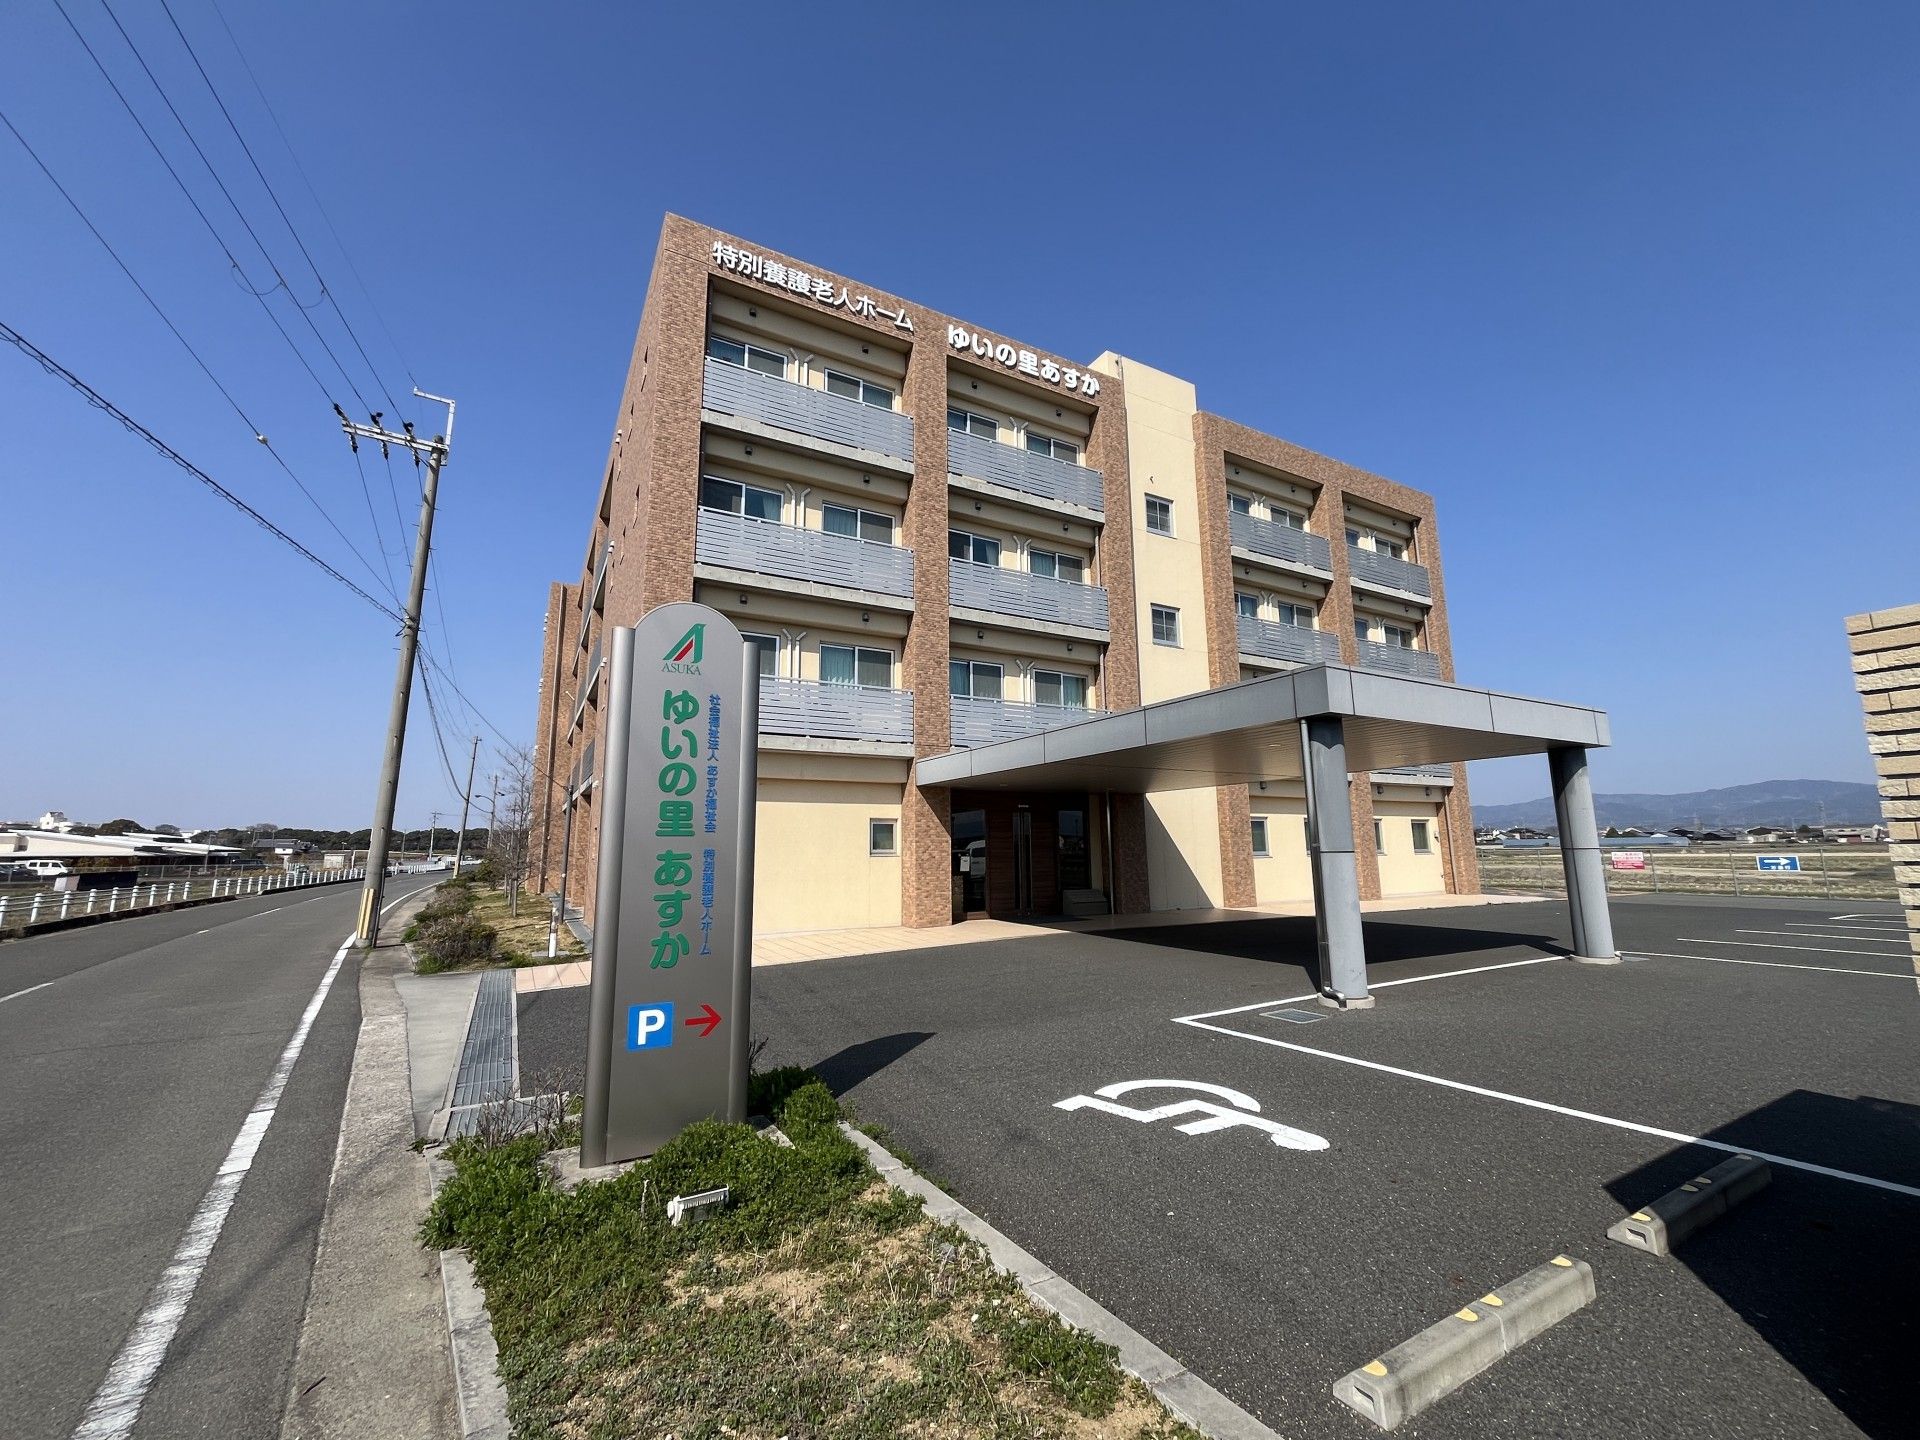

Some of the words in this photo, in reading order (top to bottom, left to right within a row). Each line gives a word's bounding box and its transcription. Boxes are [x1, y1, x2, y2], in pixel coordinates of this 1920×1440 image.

[711, 240, 914, 332] 特別養護老人ホーム
[947, 323, 1100, 397] ゆいの里あすか
[661, 662, 702, 676] ASUKA
[655, 689, 700, 838] ゆいの里
[650, 849, 693, 969] あすか
[699, 847, 717, 955] 特別養護老人ホーム
[637, 1009, 665, 1045] P
